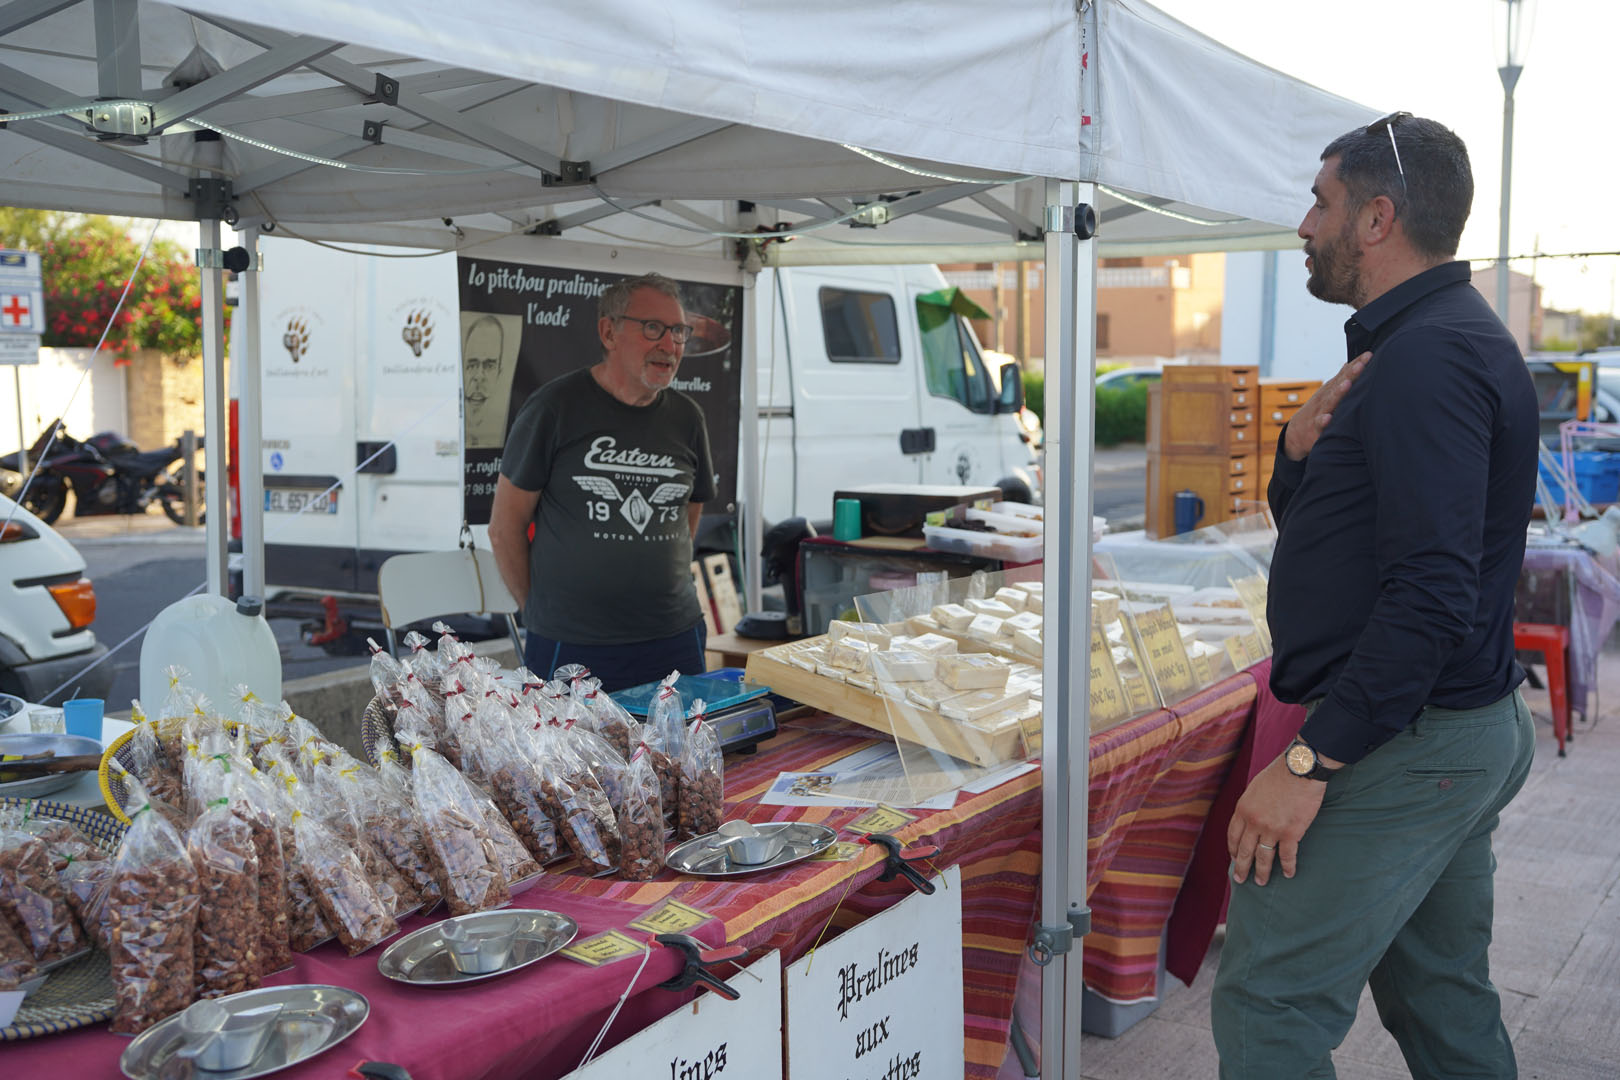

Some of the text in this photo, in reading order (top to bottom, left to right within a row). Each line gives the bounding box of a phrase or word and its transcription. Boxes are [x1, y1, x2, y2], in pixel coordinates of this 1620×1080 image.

[487, 267, 545, 295] pitchou
[583, 434, 678, 471] Eastern
[614, 473, 660, 484] DIVISION
[585, 500, 611, 522] 19
[657, 505, 680, 524] 73
[836, 941, 920, 1024] Pralines
[855, 1015, 891, 1060] aux
[669, 1041, 729, 1080] lines
